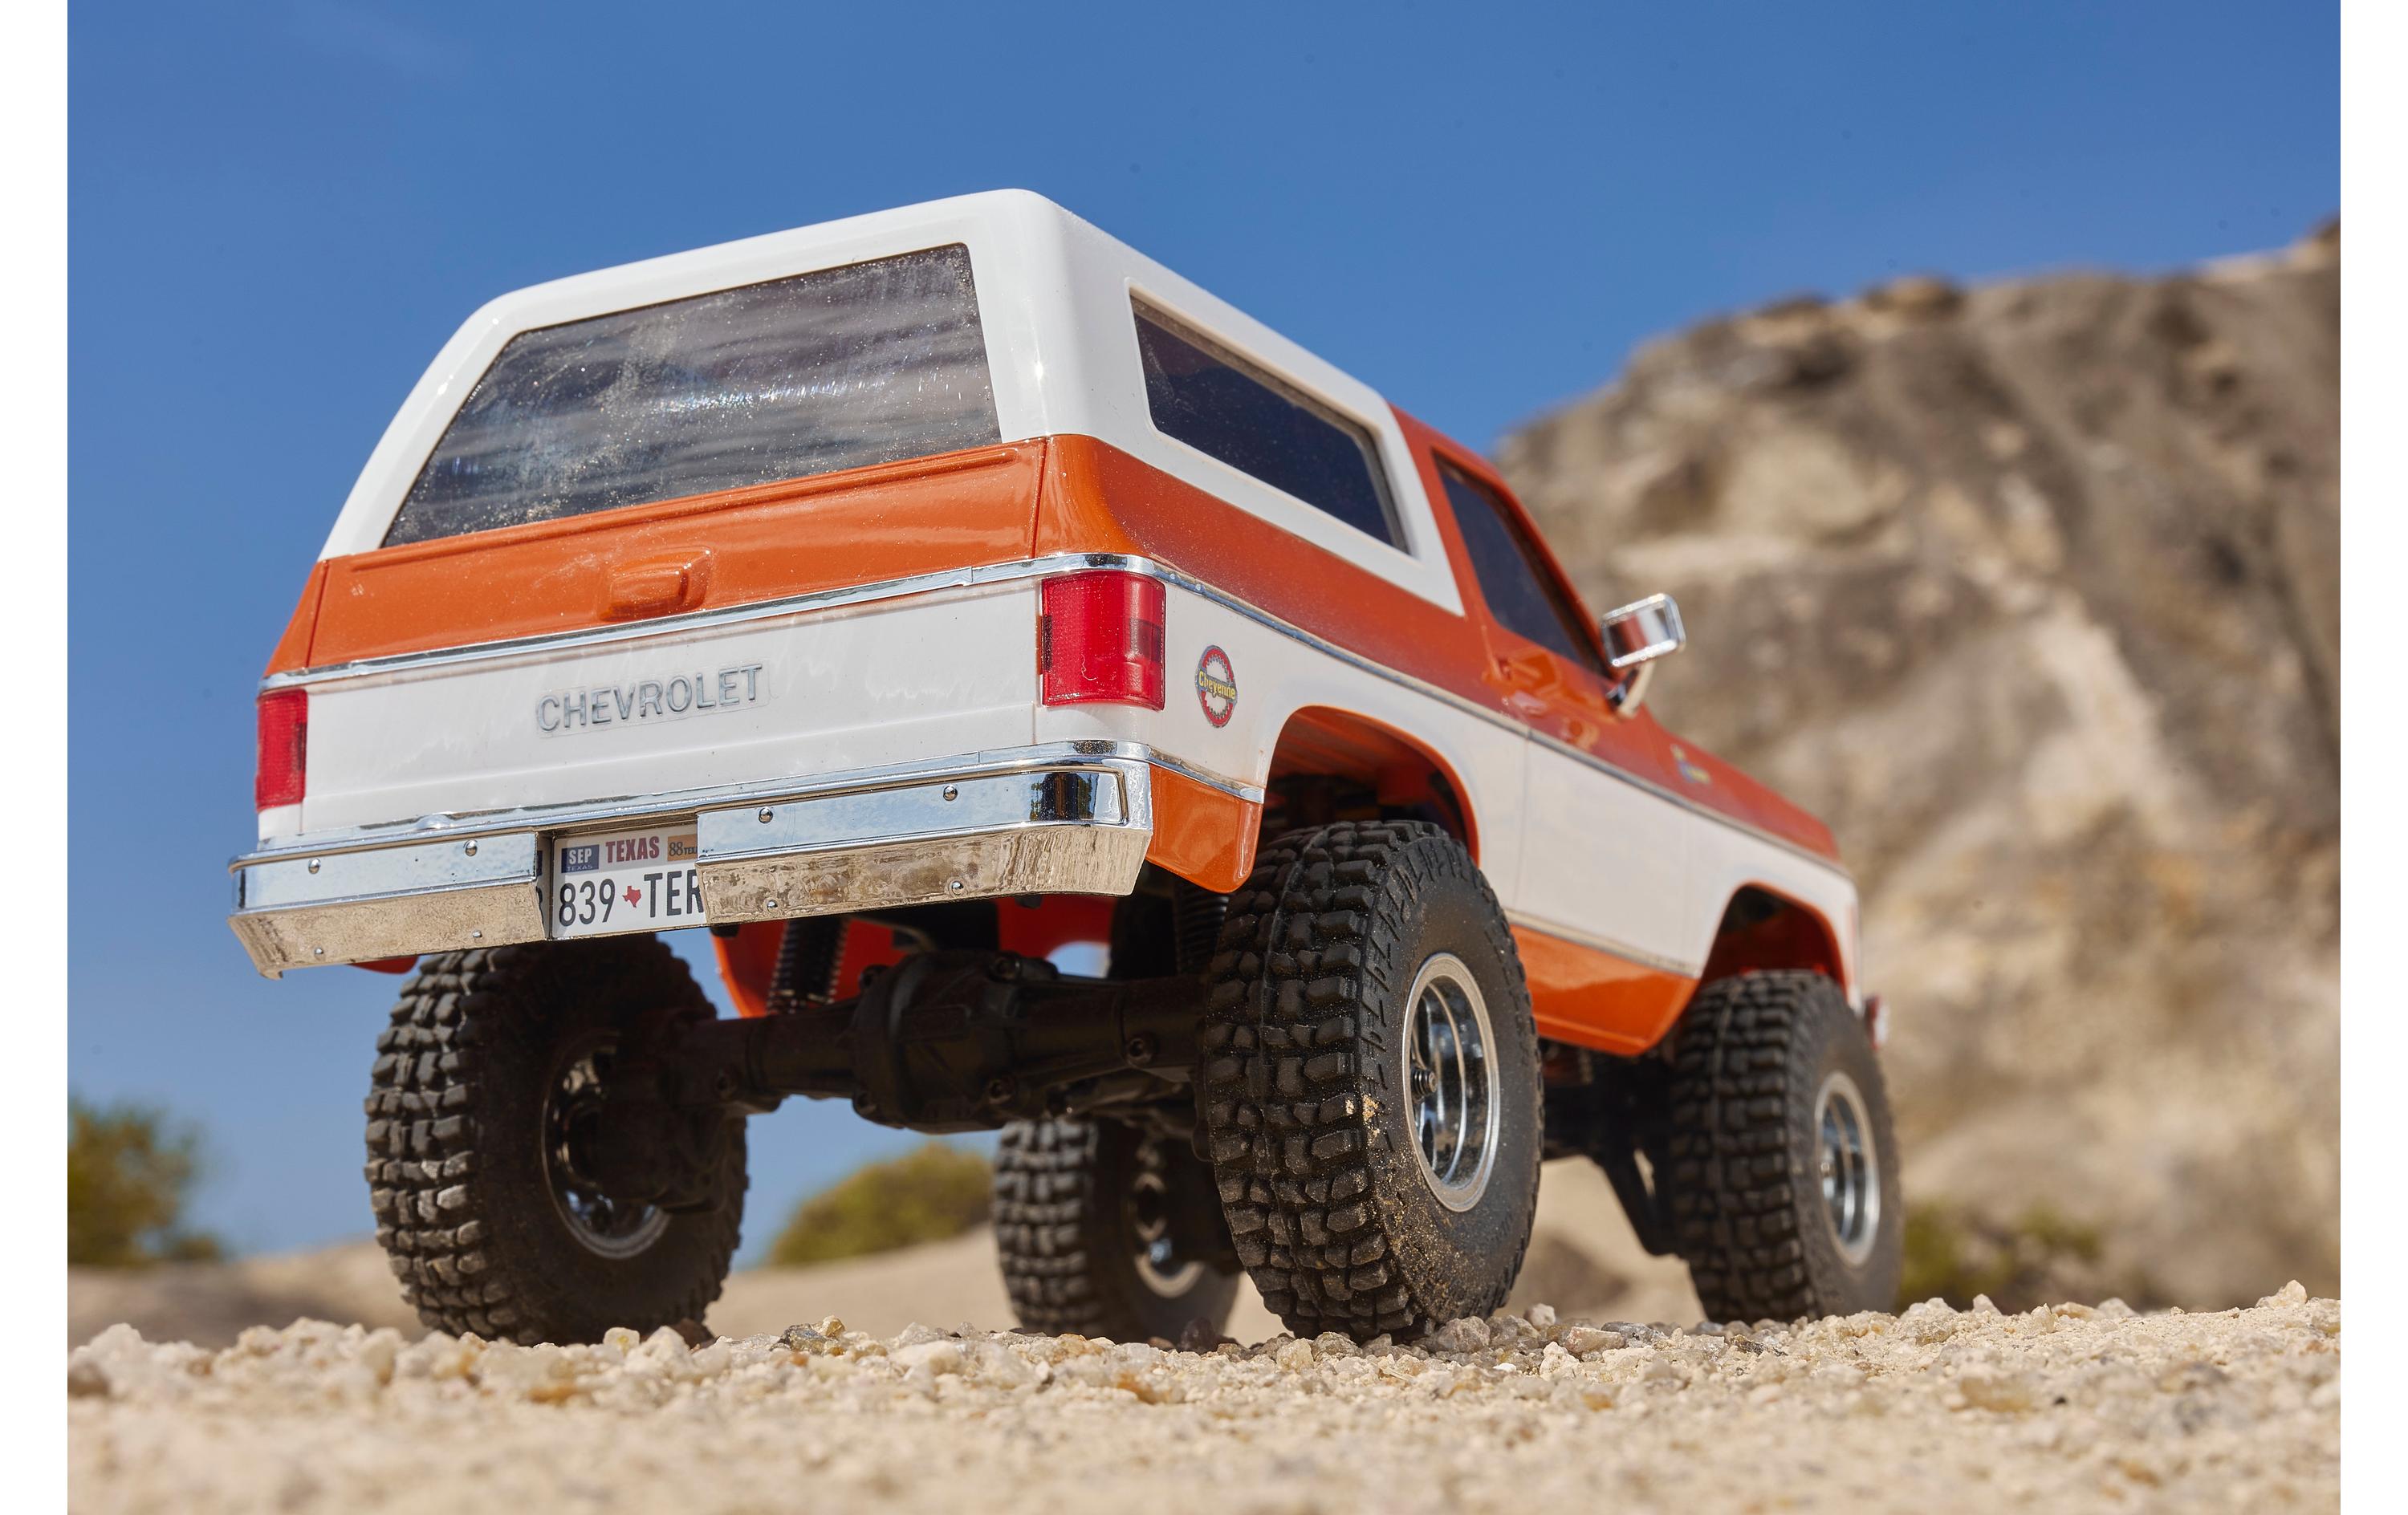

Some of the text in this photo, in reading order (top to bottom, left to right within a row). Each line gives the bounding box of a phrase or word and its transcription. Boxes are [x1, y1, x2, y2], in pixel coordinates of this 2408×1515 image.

[536, 664, 763, 732] CHEVROLET
[1198, 670, 1236, 700] Cheyenne
[568, 848, 592, 865] SEP
[605, 835, 660, 863] TEXAS
[559, 869, 704, 927] 839 TER
